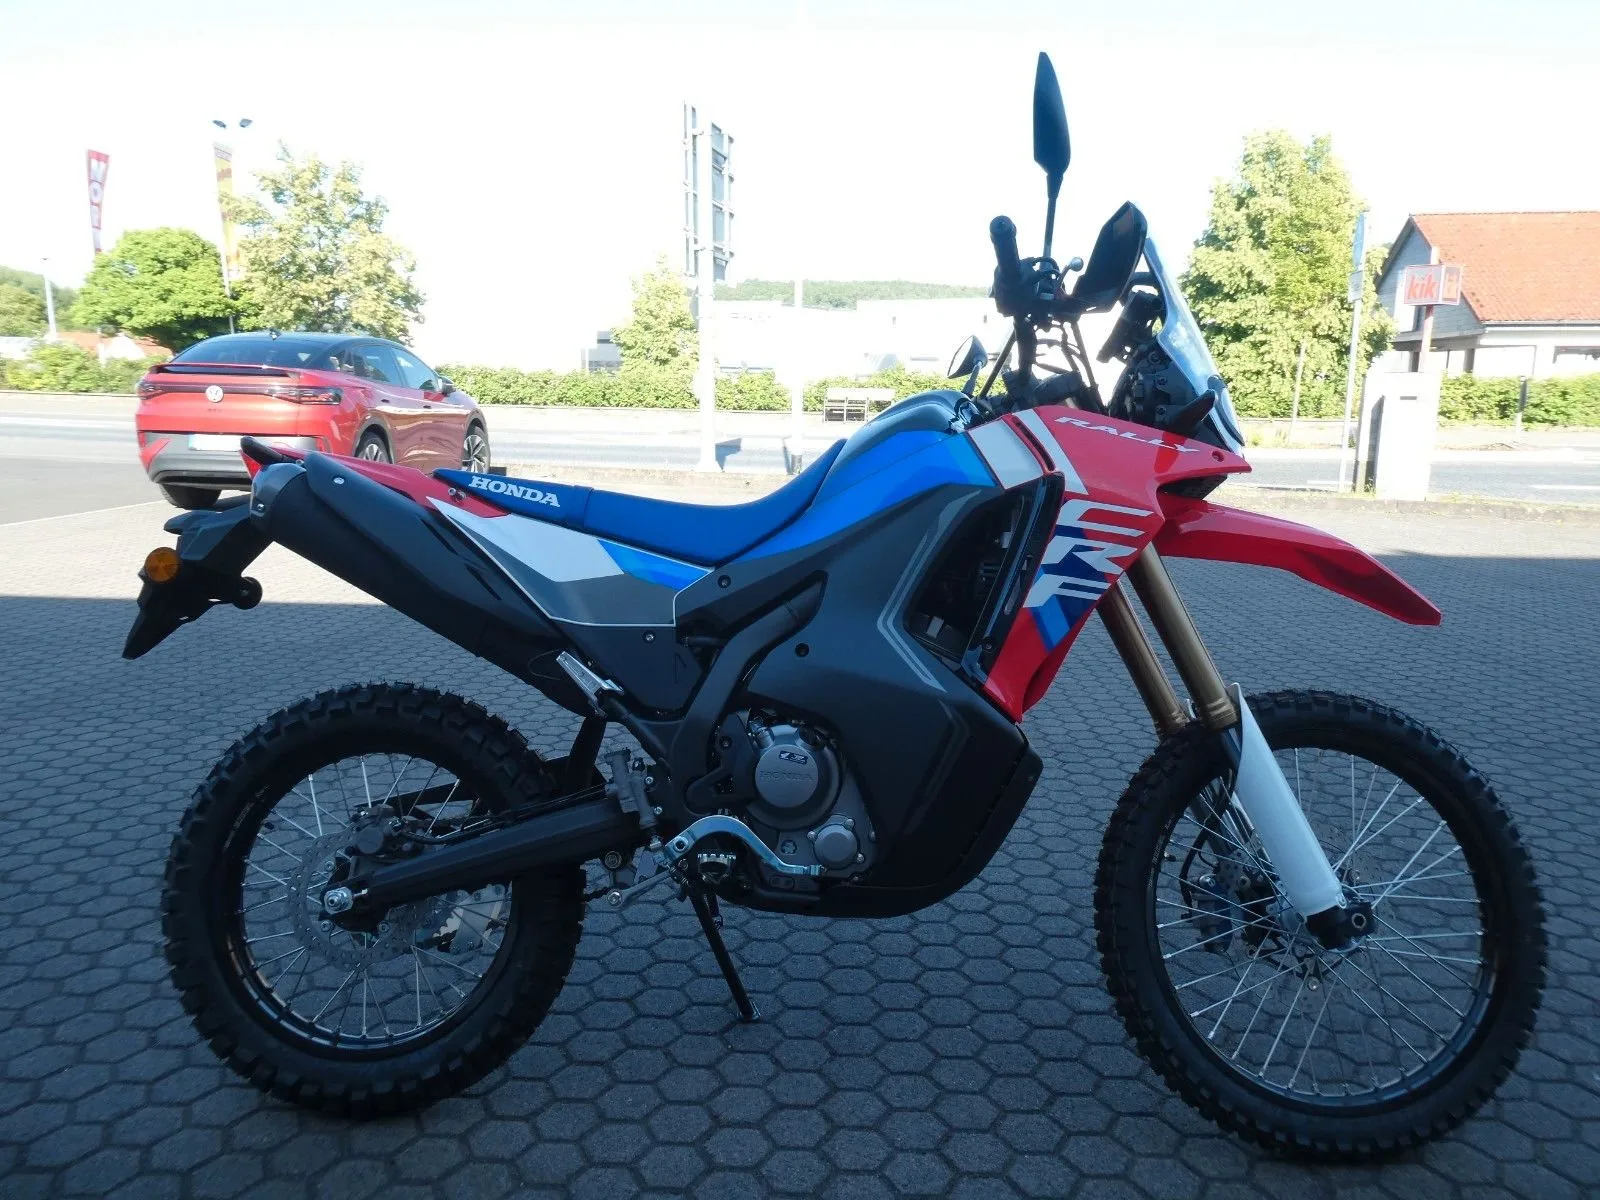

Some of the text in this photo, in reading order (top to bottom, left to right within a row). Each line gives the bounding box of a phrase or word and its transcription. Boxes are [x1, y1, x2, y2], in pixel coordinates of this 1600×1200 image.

[1054, 416, 1200, 452] RALLY
[468, 475, 561, 507] HONDA
[1023, 499, 1154, 609] CRF
